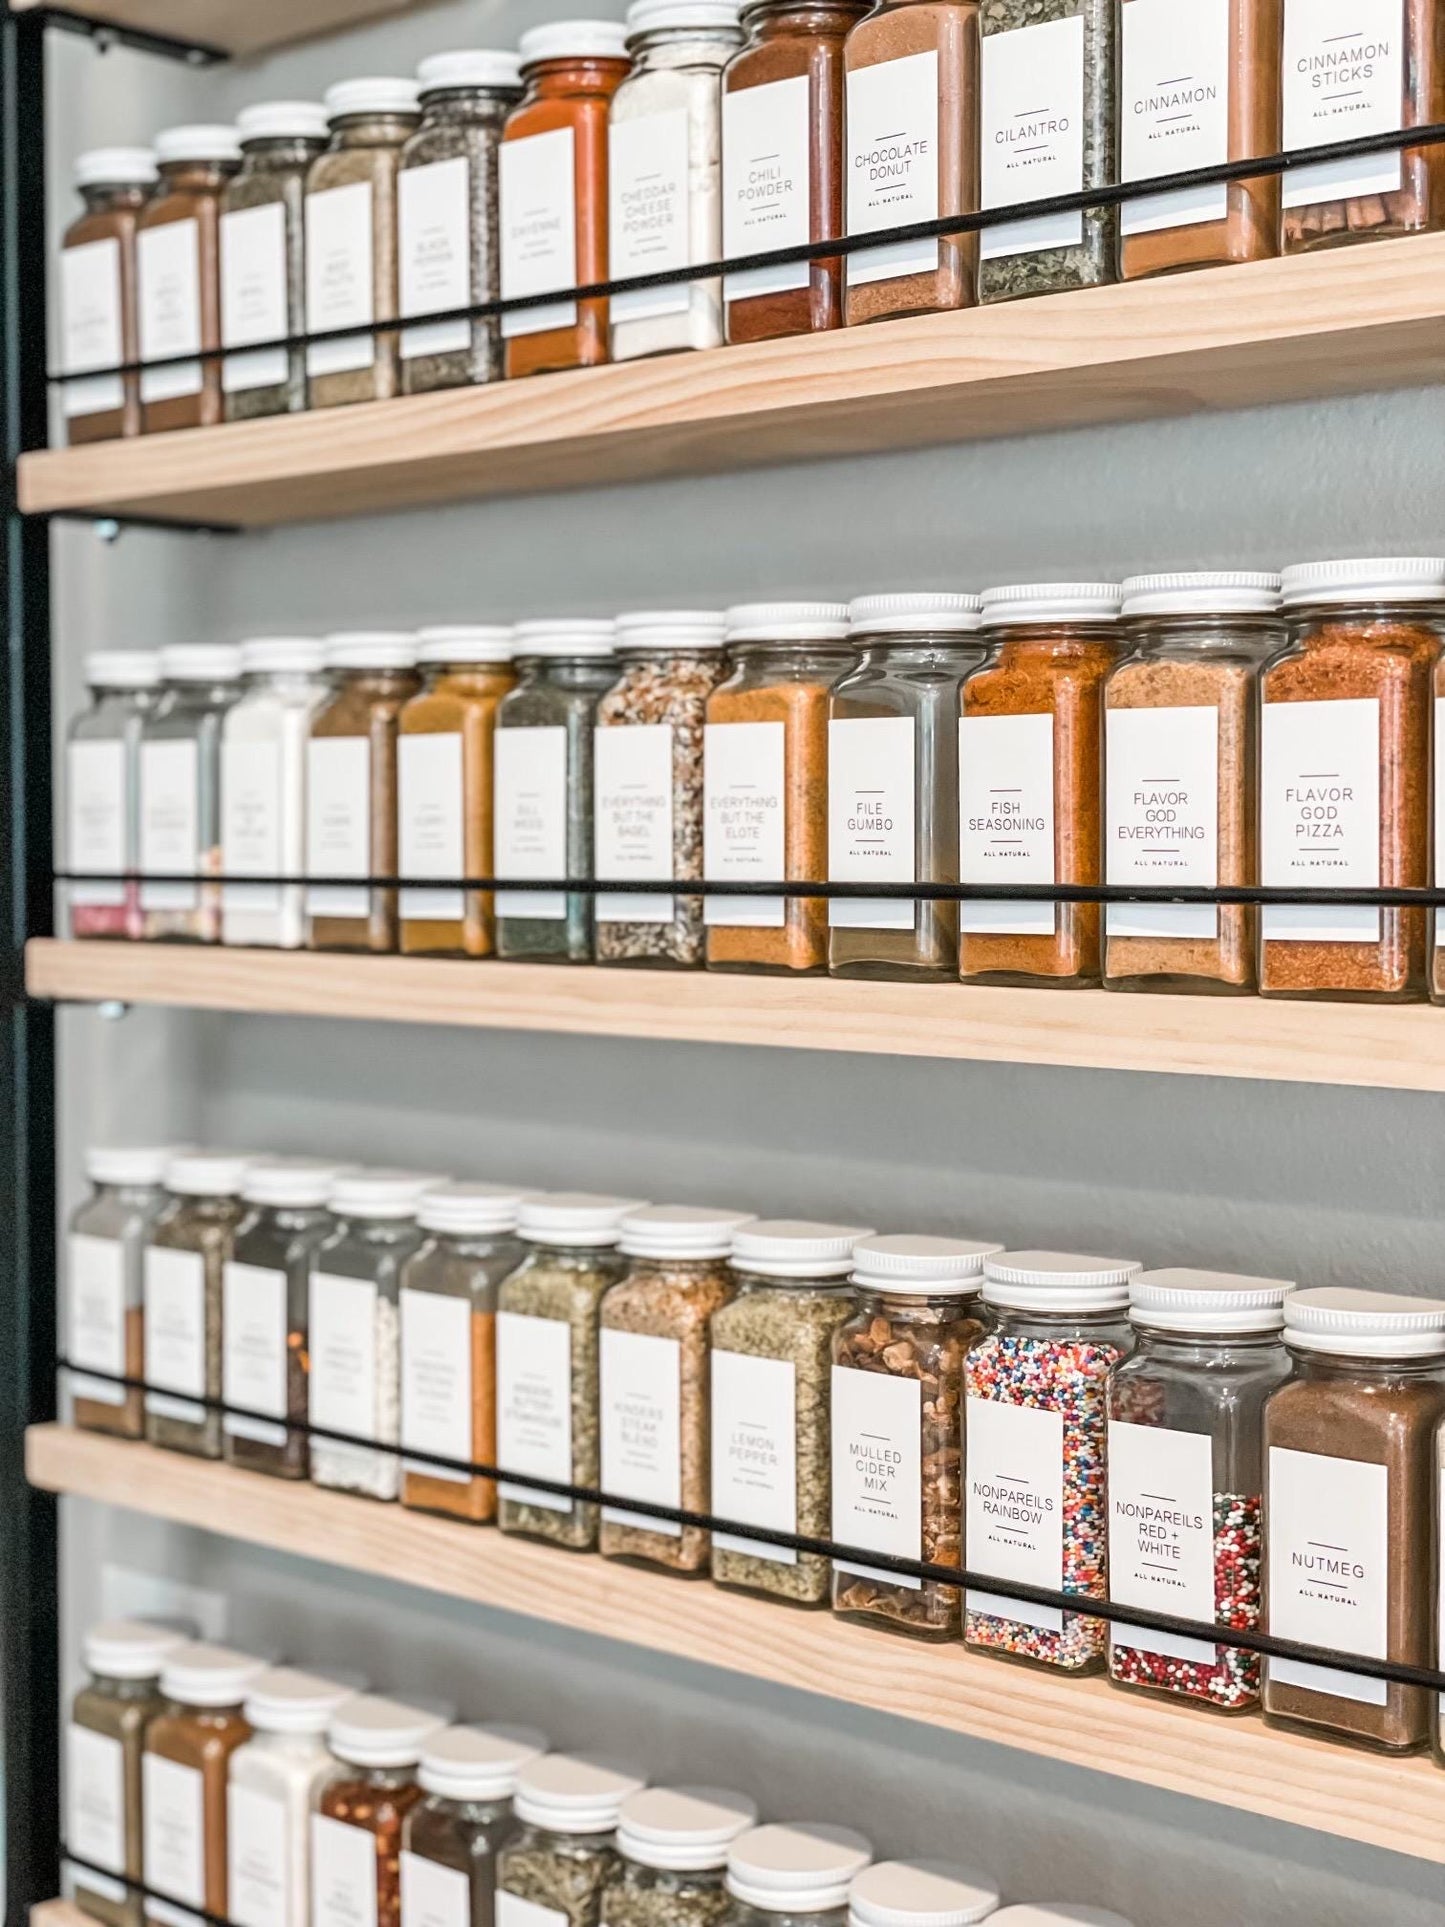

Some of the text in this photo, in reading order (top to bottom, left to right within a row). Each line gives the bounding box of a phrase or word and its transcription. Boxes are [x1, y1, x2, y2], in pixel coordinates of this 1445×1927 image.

[1297, 42, 1388, 72] CINNAMON
[1312, 64, 1373, 88] STICKS
[1134, 86, 1216, 114] CINNAMON
[1332, 102, 1372, 113] NATURAL
[995, 118, 1069, 143] CILANTRO
[1165, 125, 1201, 135] NATURAL
[855, 141, 927, 168] CHOCOLATE
[1023, 154, 1057, 165] NATURAL
[749, 167, 780, 184] CHILI
[870, 160, 911, 180] DONUT
[620, 182, 676, 204] CHEDDAR
[738, 180, 792, 200] POWDER
[883, 194, 913, 203] NATURAL
[625, 198, 672, 219] CHEESE
[623, 213, 673, 233] POWDER
[758, 213, 787, 222] NATURAL
[602, 795, 666, 809] EVERYTHING
[709, 795, 778, 809] EVERYTHING
[1134, 792, 1188, 805] FLAVOR
[1286, 788, 1353, 802] FLAVOR
[857, 803, 882, 815] FILE
[992, 802, 1020, 814] FISH
[1146, 809, 1176, 822] GOD
[1301, 806, 1337, 820] GOD
[612, 810, 653, 823] BUT THE
[720, 811, 764, 824] BUT THE
[969, 818, 1044, 830] SEASONING
[848, 819, 893, 830] GUMBO
[1296, 824, 1343, 837] PIZZA
[725, 826, 760, 839] ELOTE
[1119, 826, 1204, 839] EVERYTHING
[732, 1433, 774, 1450] LEMON
[729, 1446, 778, 1466] PEPPER
[850, 1443, 901, 1464] MULLED
[856, 1460, 895, 1478] CIDER
[865, 1477, 887, 1491] MIX
[974, 1482, 1053, 1511] NONPAREILS
[869, 1508, 898, 1519] NATURAL
[984, 1501, 1042, 1524] RAINBOW
[1117, 1501, 1203, 1529] NONPAREILS
[1139, 1523, 1166, 1539] RED
[988, 1534, 1037, 1550] ALL NATURAL
[1138, 1539, 1180, 1559] WHITE
[1293, 1552, 1364, 1578] NUTMEG
[1151, 1575, 1187, 1587] NATURAL
[1298, 1589, 1357, 1606] ALL NATURAL
